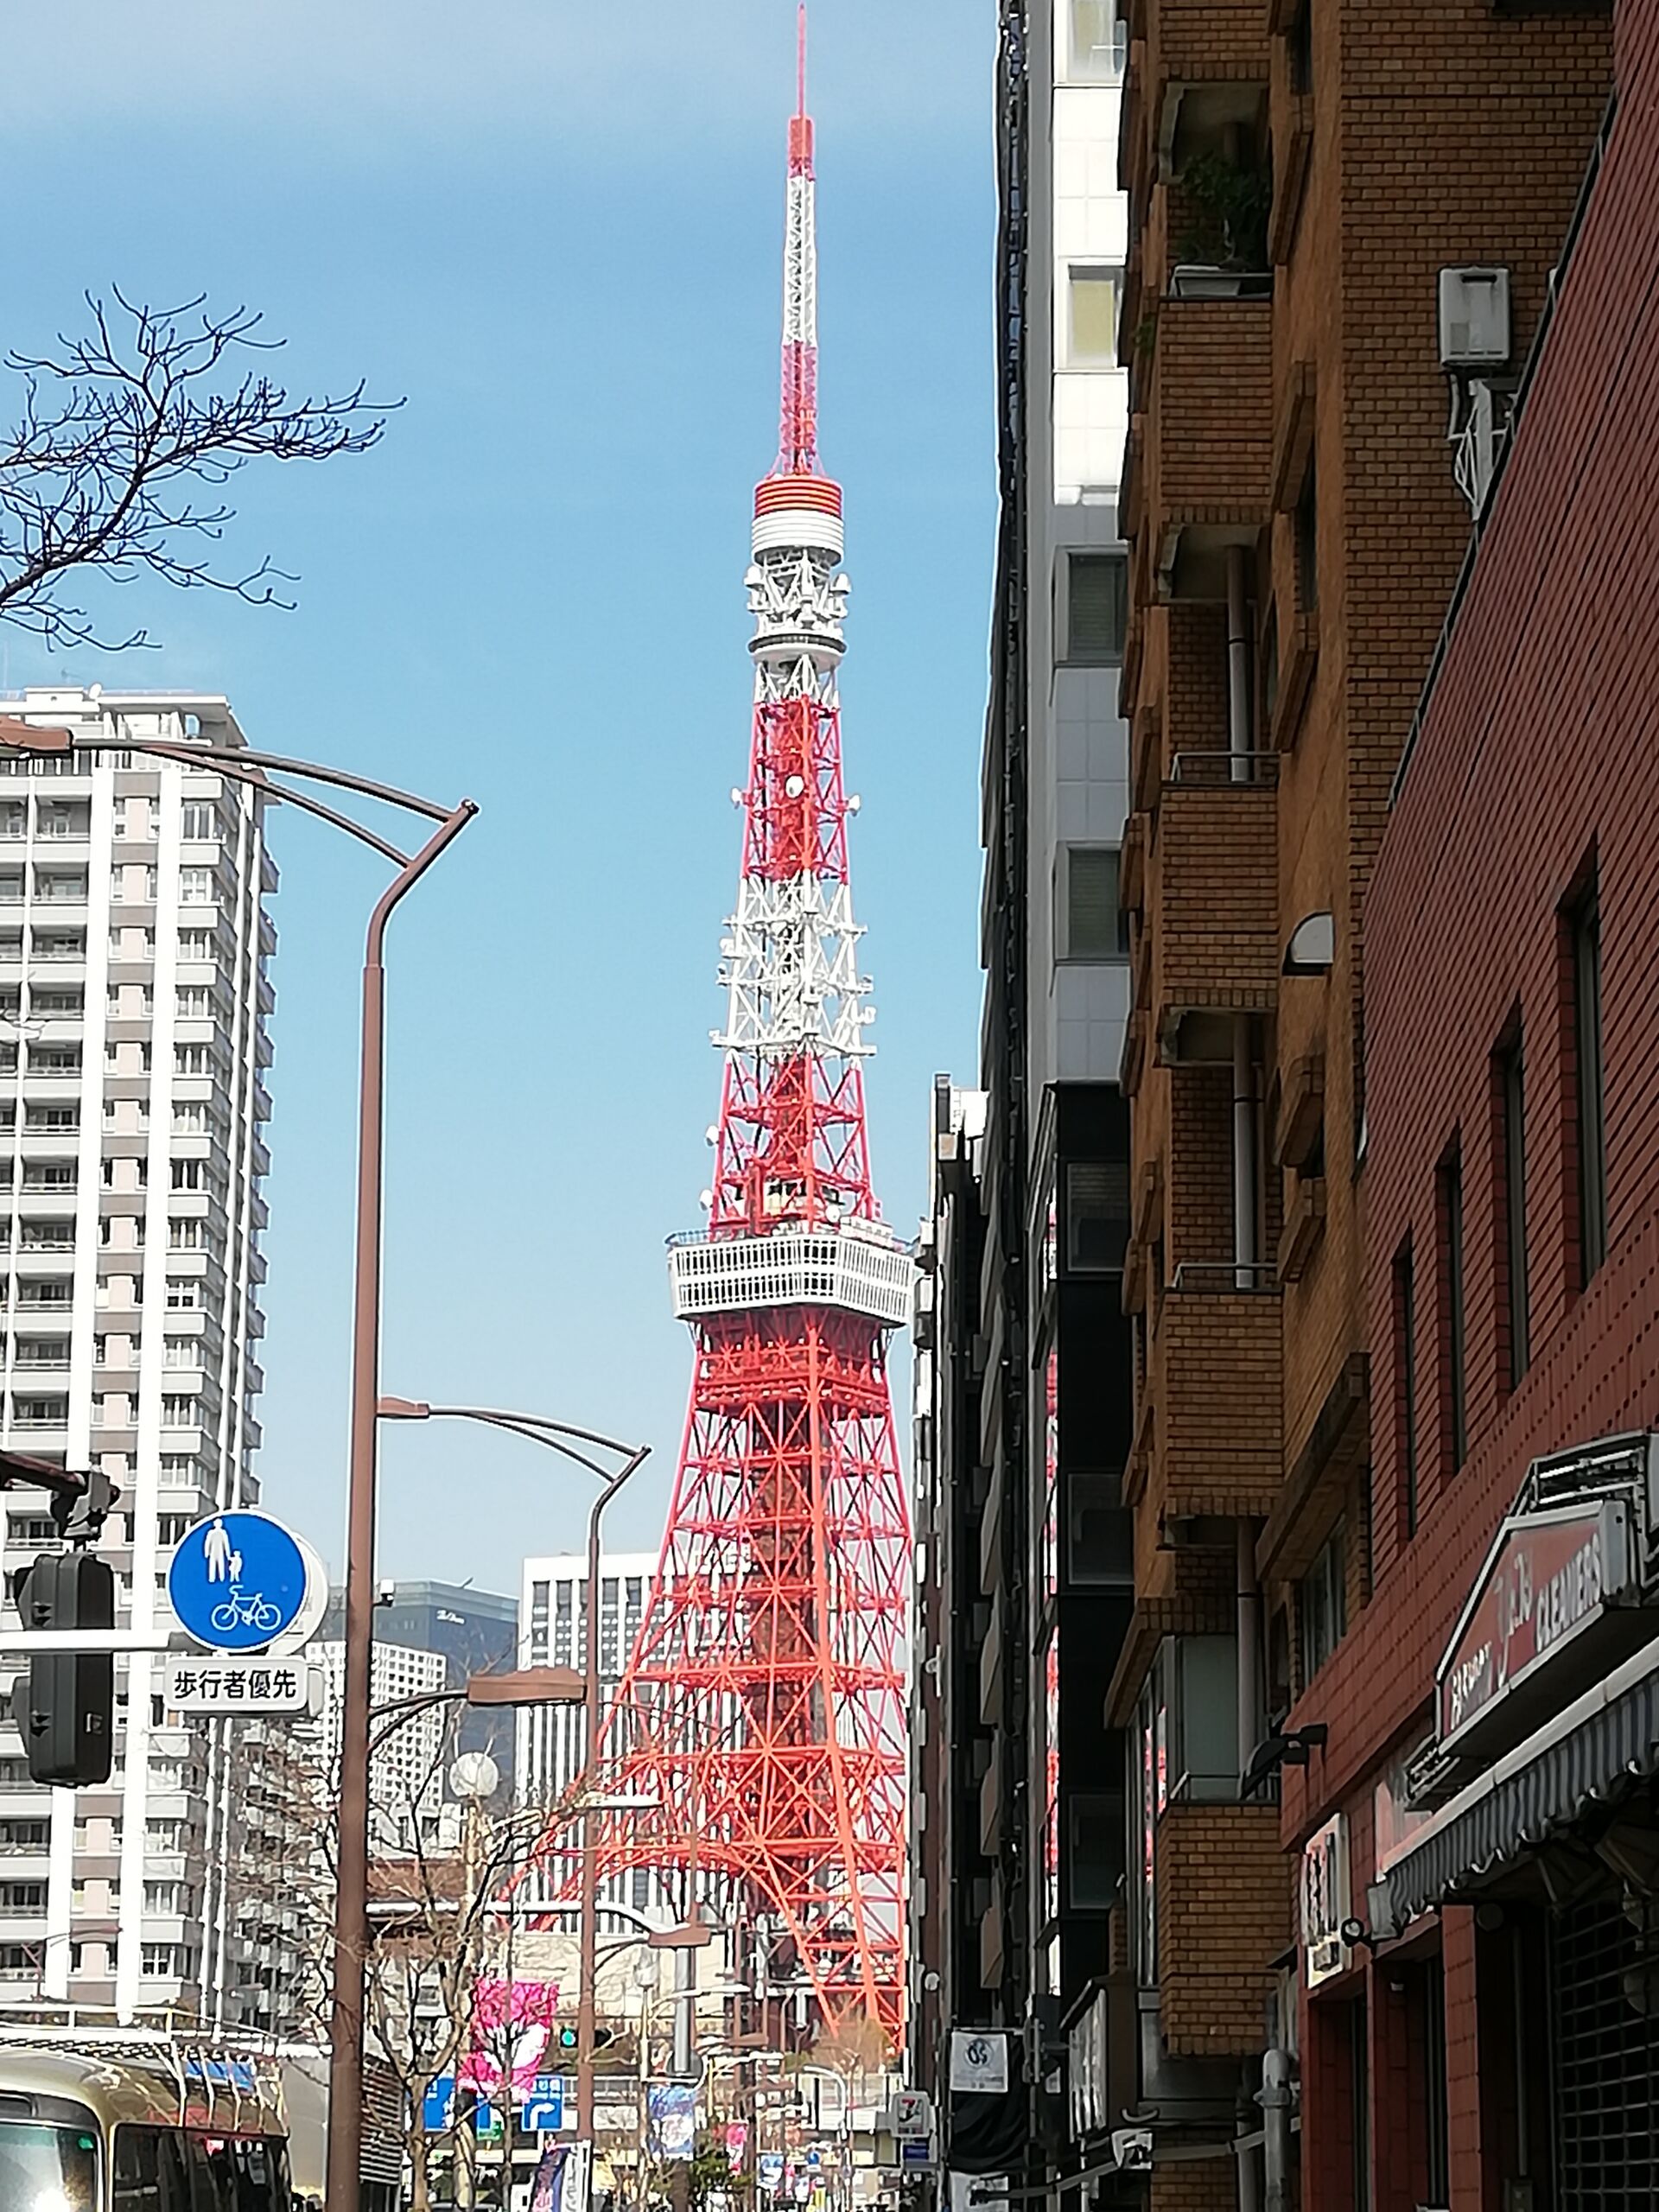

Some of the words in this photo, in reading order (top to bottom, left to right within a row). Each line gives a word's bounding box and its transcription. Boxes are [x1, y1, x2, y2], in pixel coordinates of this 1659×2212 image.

[175, 1669, 296, 1700] 歩行者優先
